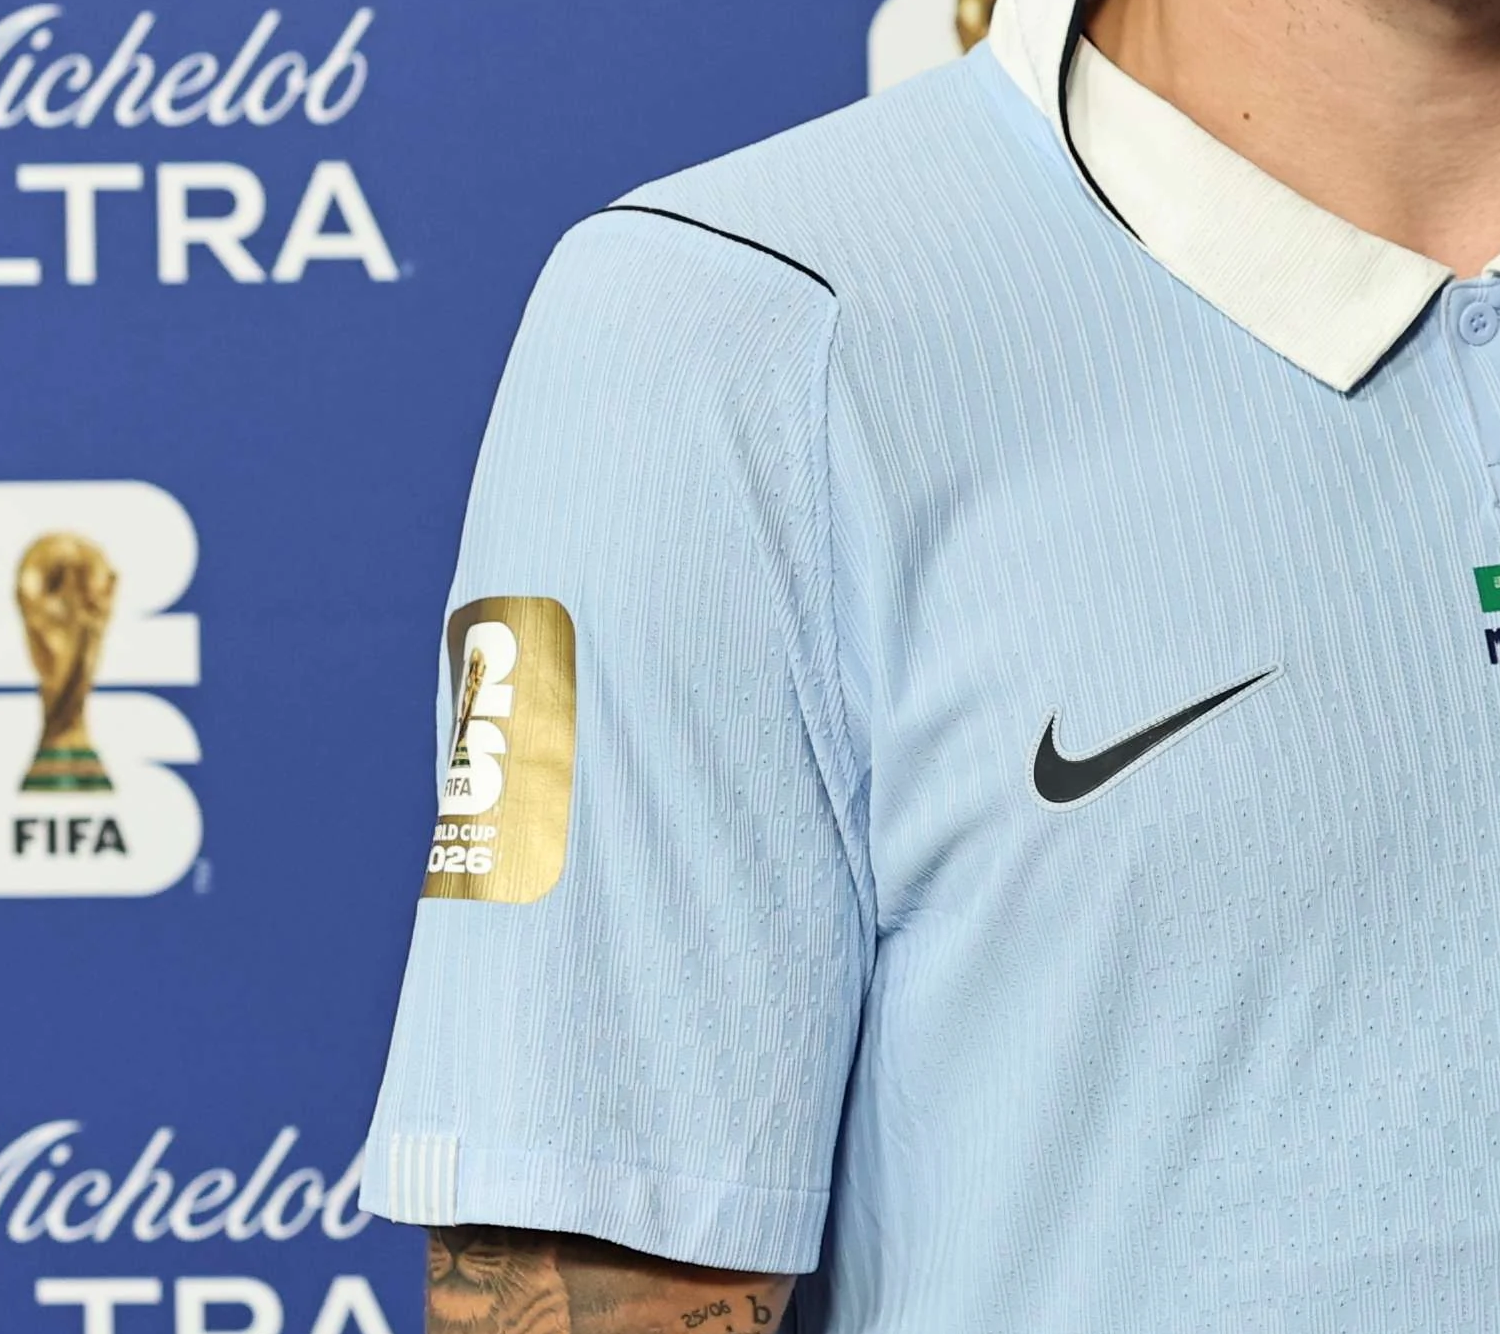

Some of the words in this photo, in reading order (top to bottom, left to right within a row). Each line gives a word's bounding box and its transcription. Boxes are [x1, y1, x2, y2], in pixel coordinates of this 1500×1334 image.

[14, 818, 126, 854] FIFA
[460, 823, 497, 842] CUP
[428, 845, 493, 874] 026
